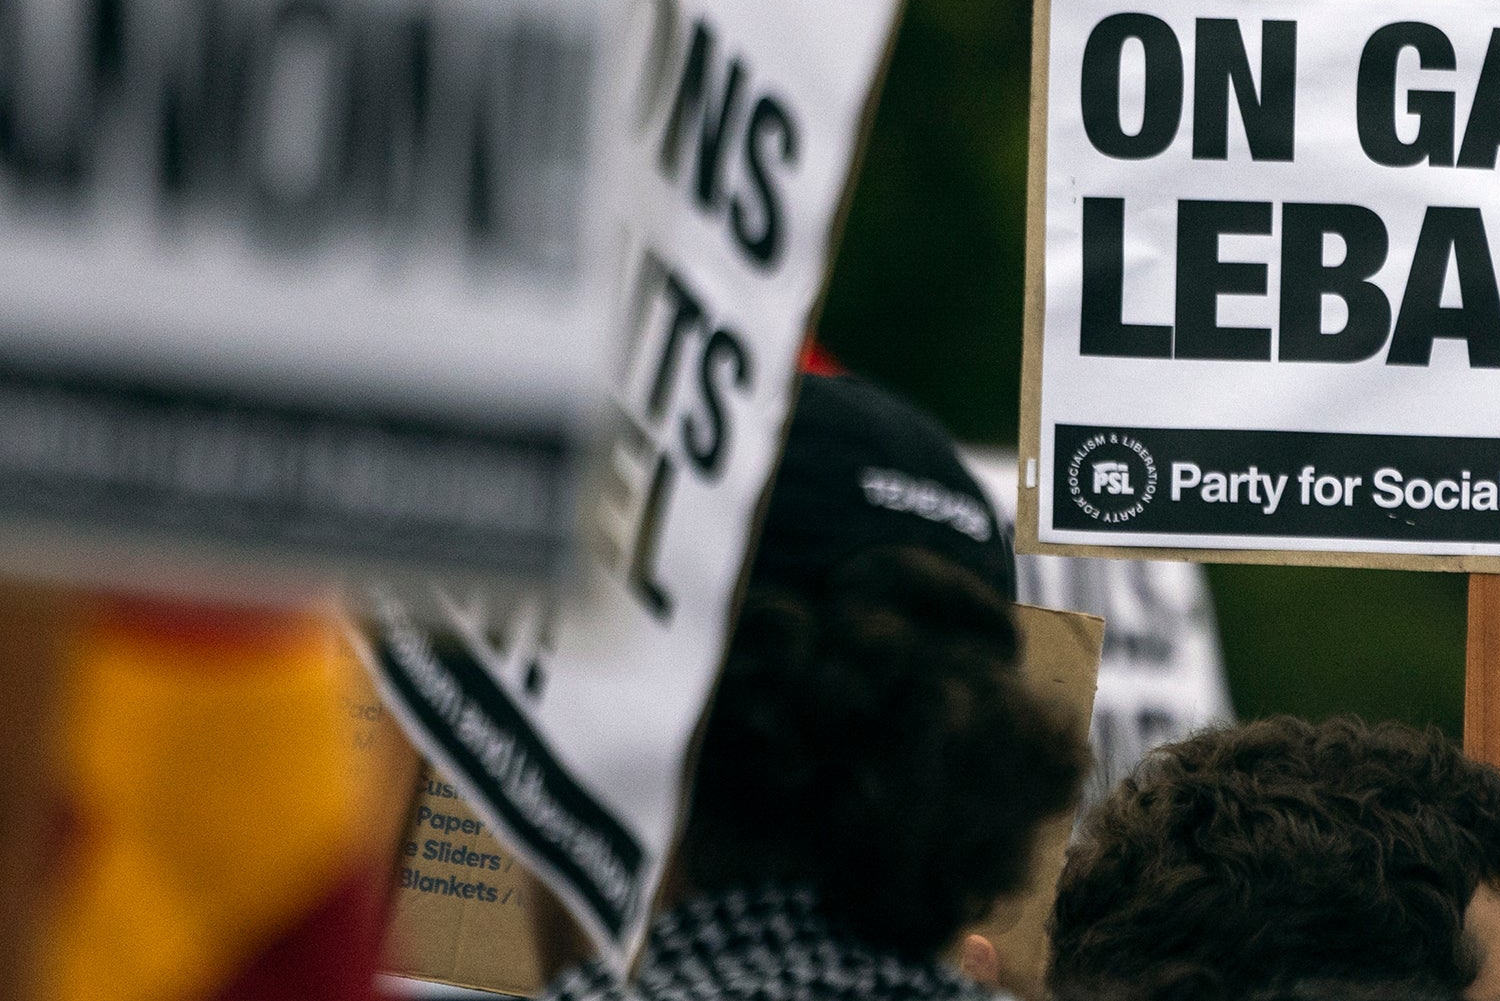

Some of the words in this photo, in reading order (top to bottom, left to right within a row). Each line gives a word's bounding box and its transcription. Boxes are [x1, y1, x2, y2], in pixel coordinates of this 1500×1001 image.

[1079, 12, 1298, 162] ON
[1068, 434, 1106, 496] SOCIALISM
[1093, 468, 1135, 495] PSL
[1122, 436, 1158, 504] LIBERATION
[1170, 461, 1289, 515] Party
[1298, 466, 1363, 507] for
[1103, 502, 1145, 524] PARTY
[416, 805, 486, 836] Paper
[422, 839, 502, 872] Sliders
